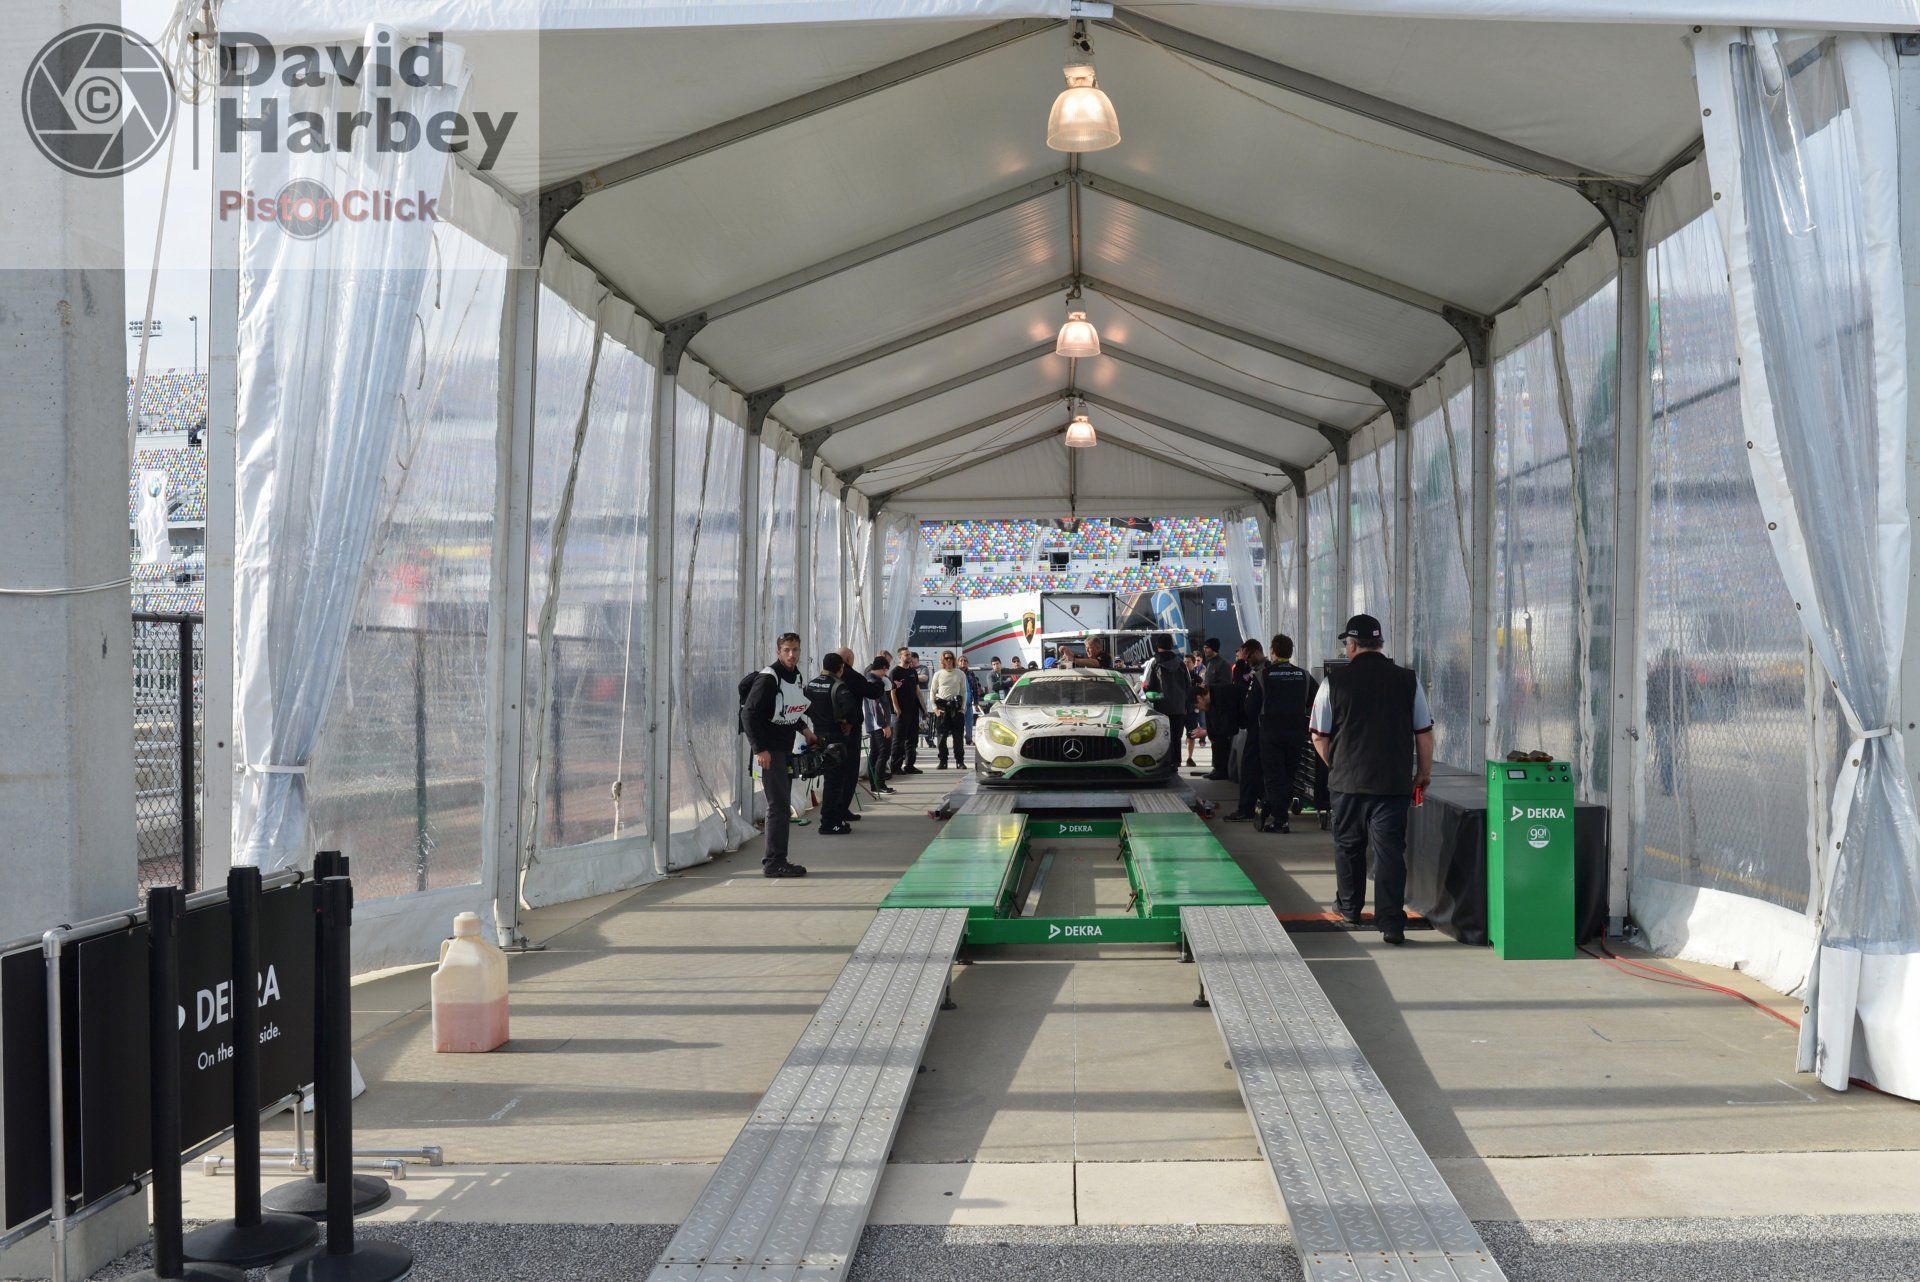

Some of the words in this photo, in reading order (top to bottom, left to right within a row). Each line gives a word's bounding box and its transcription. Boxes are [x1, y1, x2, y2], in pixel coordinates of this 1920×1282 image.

[1527, 807, 1566, 819] DEKRA
[1069, 825, 1093, 833] DEKRA
[1065, 925, 1103, 937] DEKRA
[197, 1051, 215, 1070] On
[217, 1041, 234, 1063] the
[258, 1021, 281, 1044] side.
